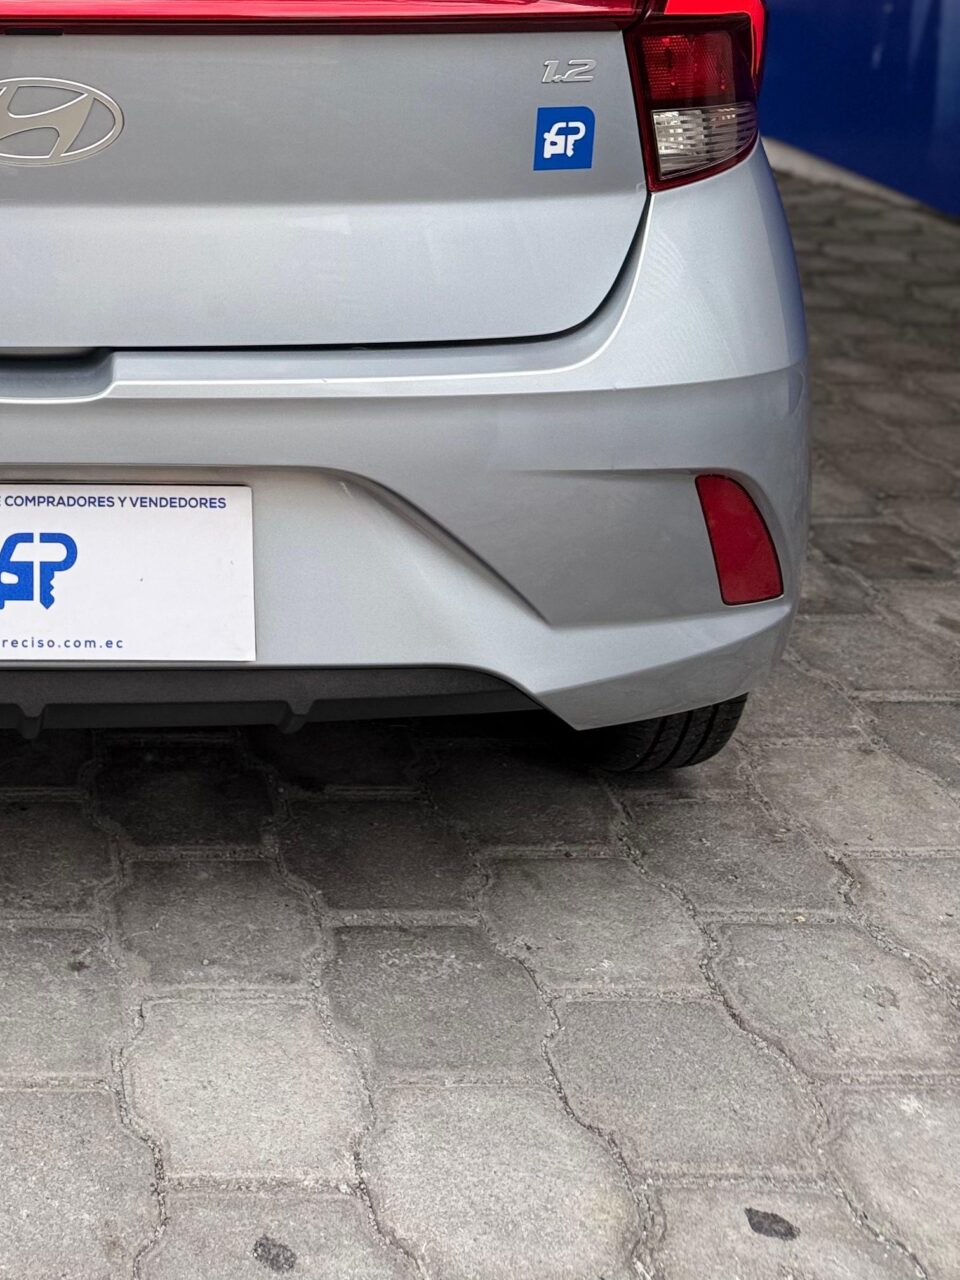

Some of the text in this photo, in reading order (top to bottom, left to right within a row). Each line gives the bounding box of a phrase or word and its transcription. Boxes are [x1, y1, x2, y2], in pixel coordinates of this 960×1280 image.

[541, 58, 598, 84] 1.2
[4, 495, 115, 509] COMPRADORES
[118, 496, 128, 509] Y
[129, 496, 227, 510] VENDEDORES
